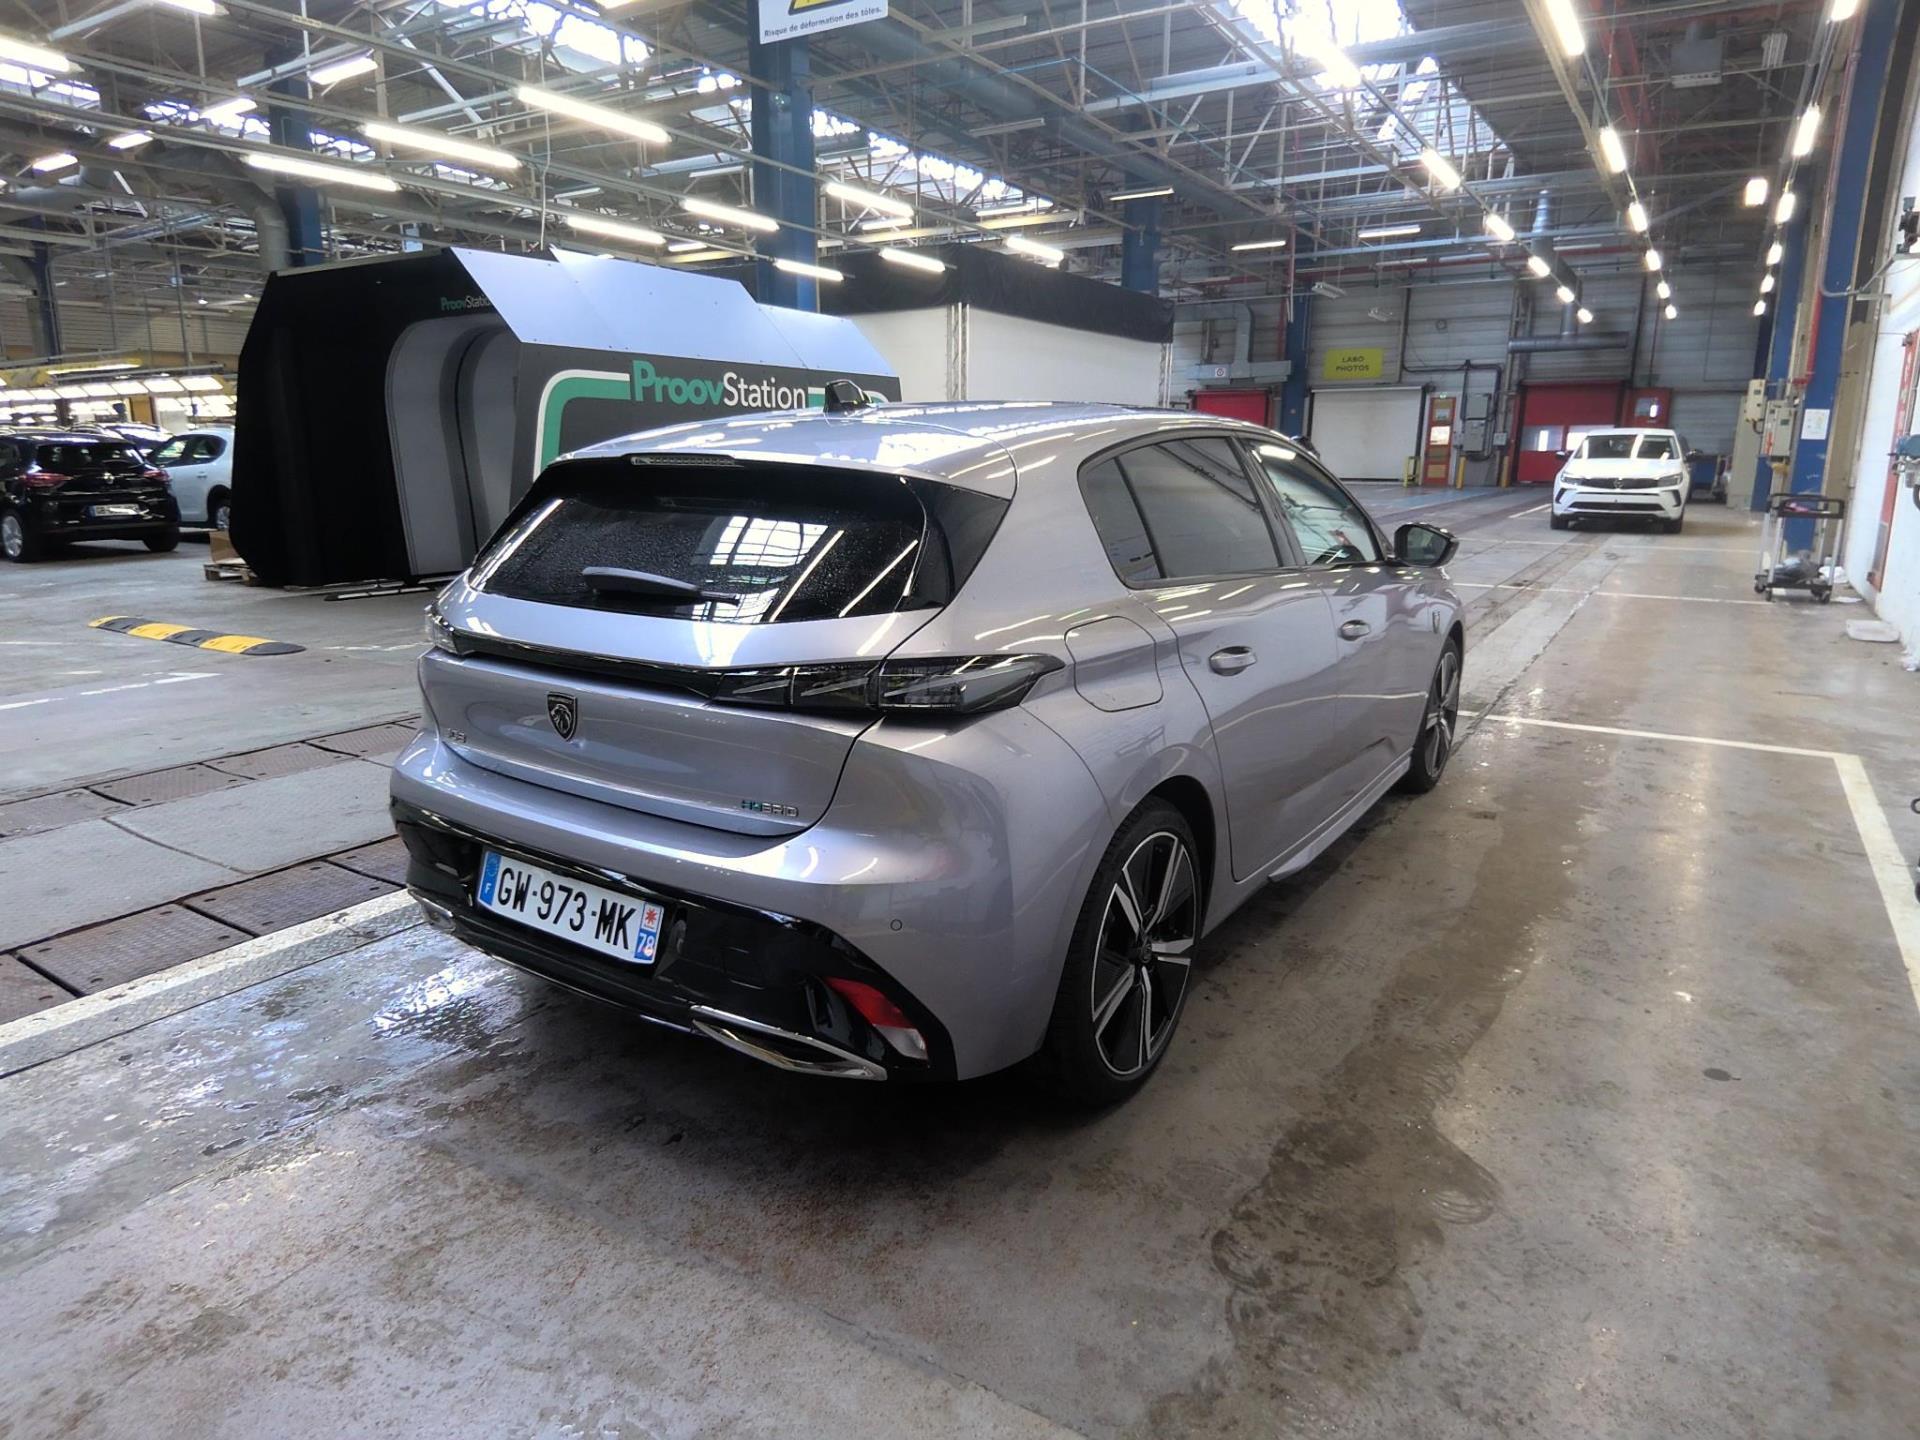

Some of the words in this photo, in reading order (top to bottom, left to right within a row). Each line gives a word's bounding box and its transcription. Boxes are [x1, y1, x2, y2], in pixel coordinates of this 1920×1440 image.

[764, 26, 788, 37] Risque
[789, 23, 799, 32] de
[800, 15, 844, 30] déformation
[845, 10, 859, 20] des
[440, 294, 491, 311] ProovStatio
[1335, 364, 1370, 372] PHOTOS
[1342, 355, 1365, 363] LABO
[632, 359, 807, 410] ProovStation
[484, 882, 493, 894] F
[498, 867, 637, 950] GW-973-MK
[638, 932, 655, 957] 78
